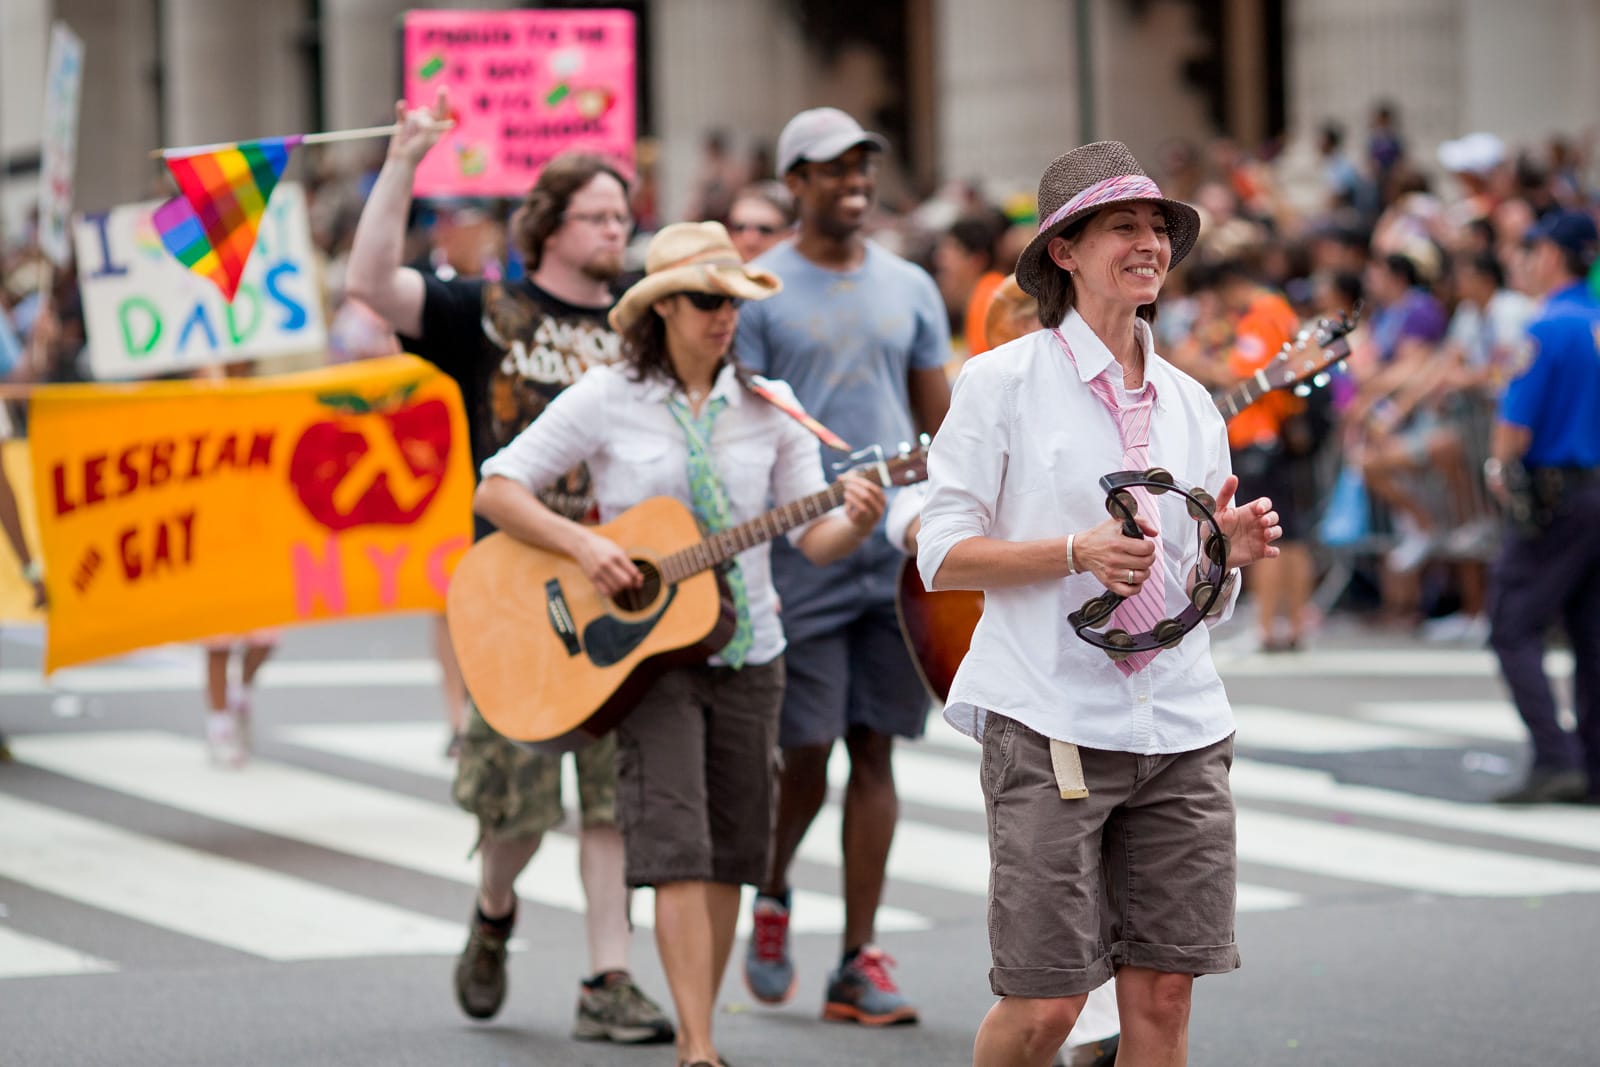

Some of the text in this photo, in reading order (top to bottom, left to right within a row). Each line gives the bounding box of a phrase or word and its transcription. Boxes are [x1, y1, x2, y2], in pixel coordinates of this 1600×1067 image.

[86, 211, 128, 278] I
[118, 262, 307, 358] DADS
[52, 430, 277, 517] LESBIAN
[116, 508, 195, 585] GAY
[291, 534, 467, 616] NYC
